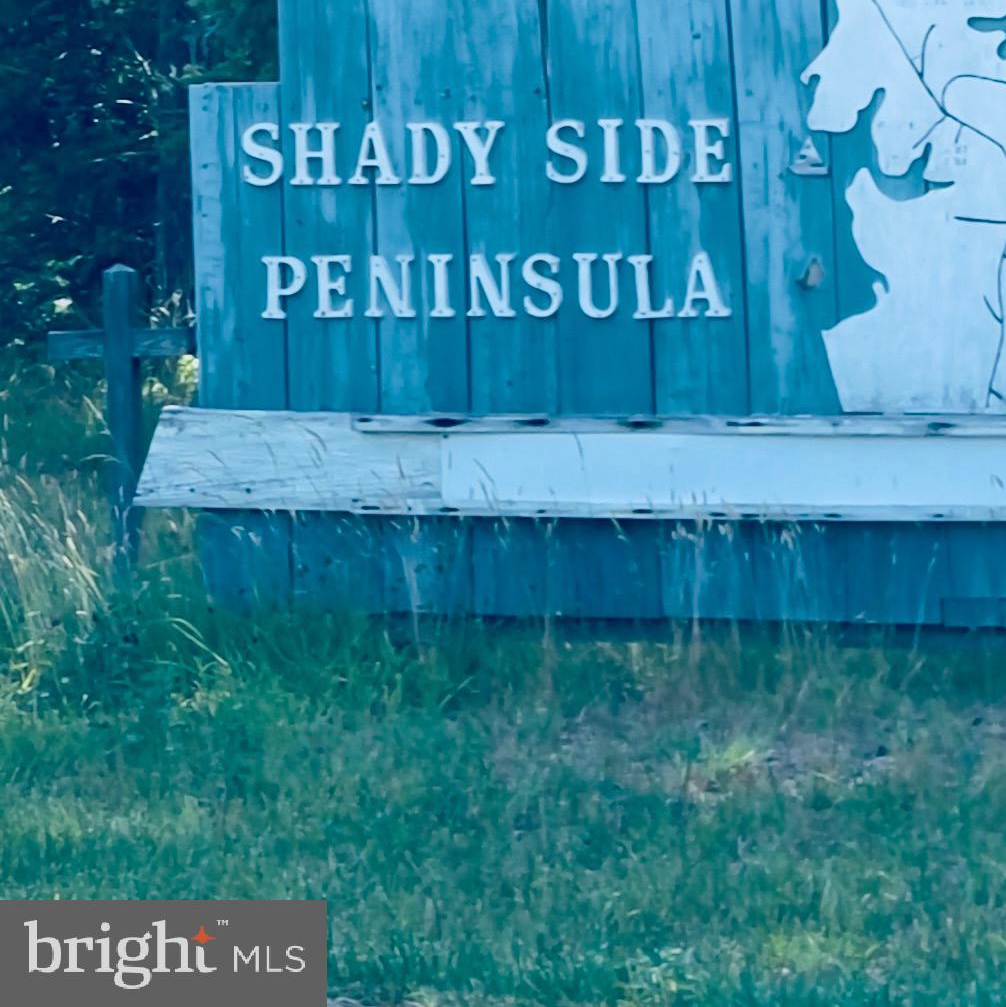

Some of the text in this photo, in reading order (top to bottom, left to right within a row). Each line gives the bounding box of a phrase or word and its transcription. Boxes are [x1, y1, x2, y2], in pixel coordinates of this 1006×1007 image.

[241, 117, 732, 186] SHADY SIDE
[260, 252, 732, 320] PENINSULA
